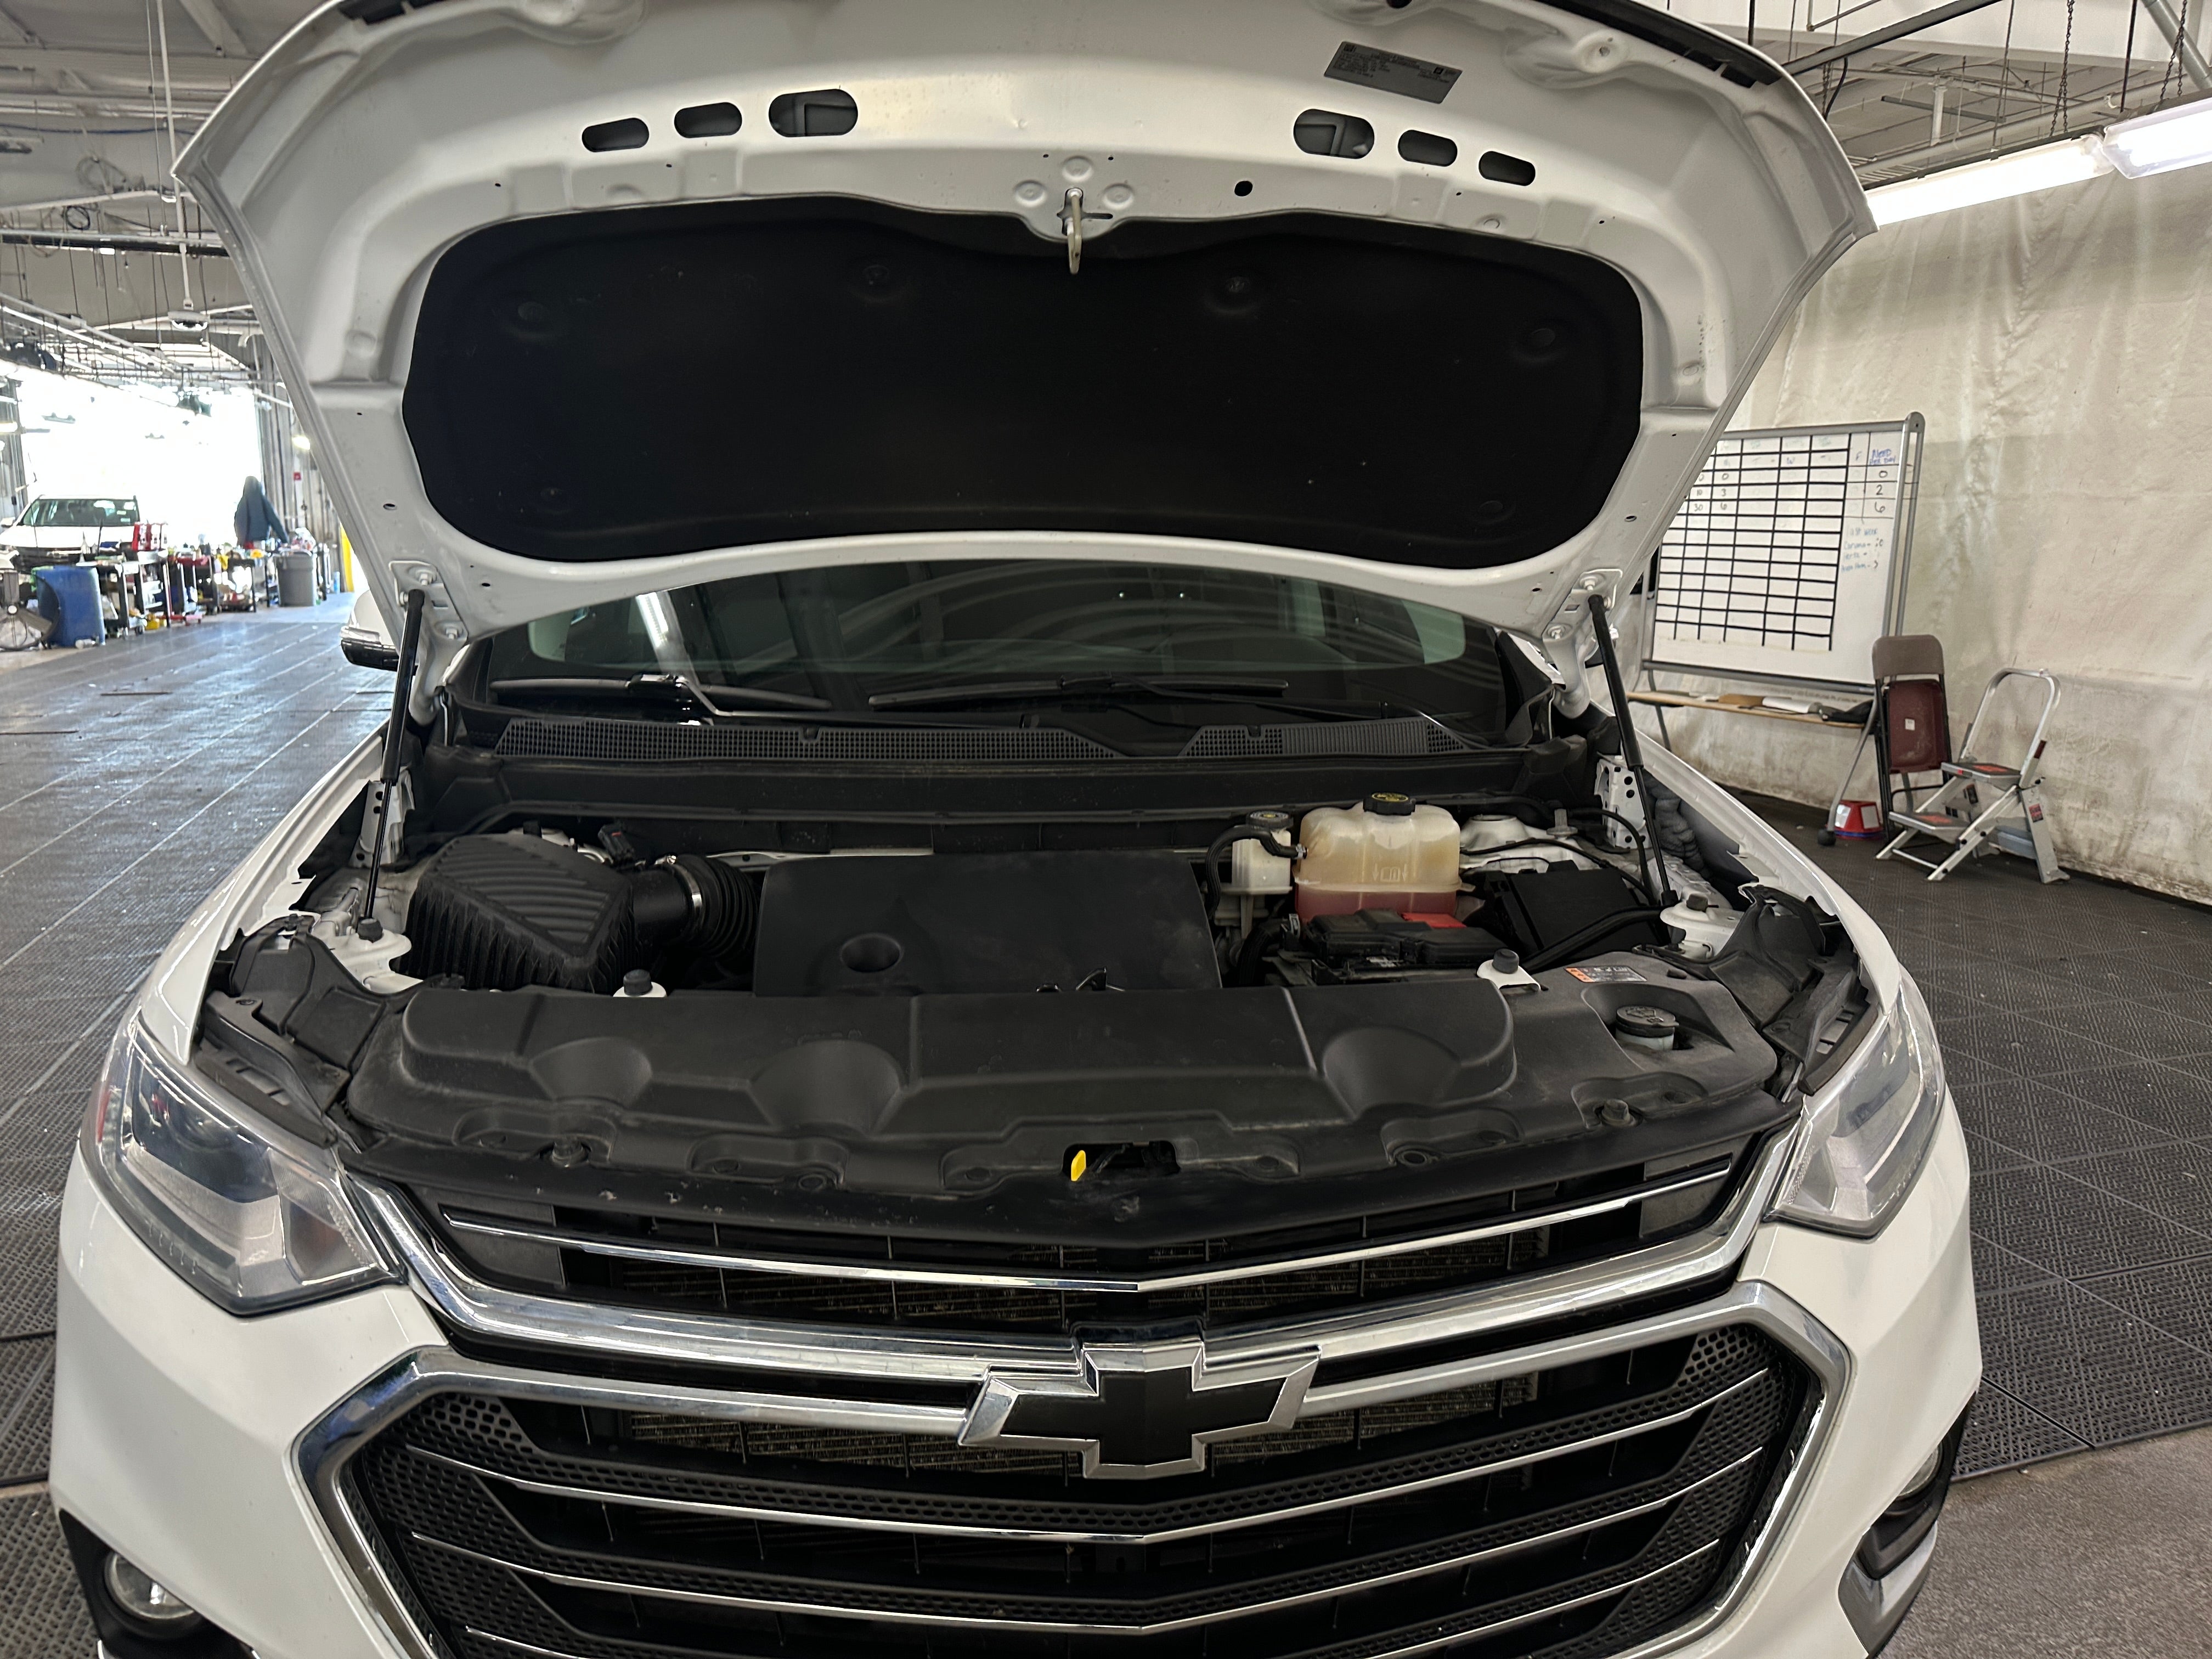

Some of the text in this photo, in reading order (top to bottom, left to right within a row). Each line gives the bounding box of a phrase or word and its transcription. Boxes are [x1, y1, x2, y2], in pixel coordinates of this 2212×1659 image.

[1878, 470, 1888, 478] 0
[1721, 488, 1726, 496] 3
[1876, 484, 1883, 495] 2
[1875, 501, 1886, 513] 6
